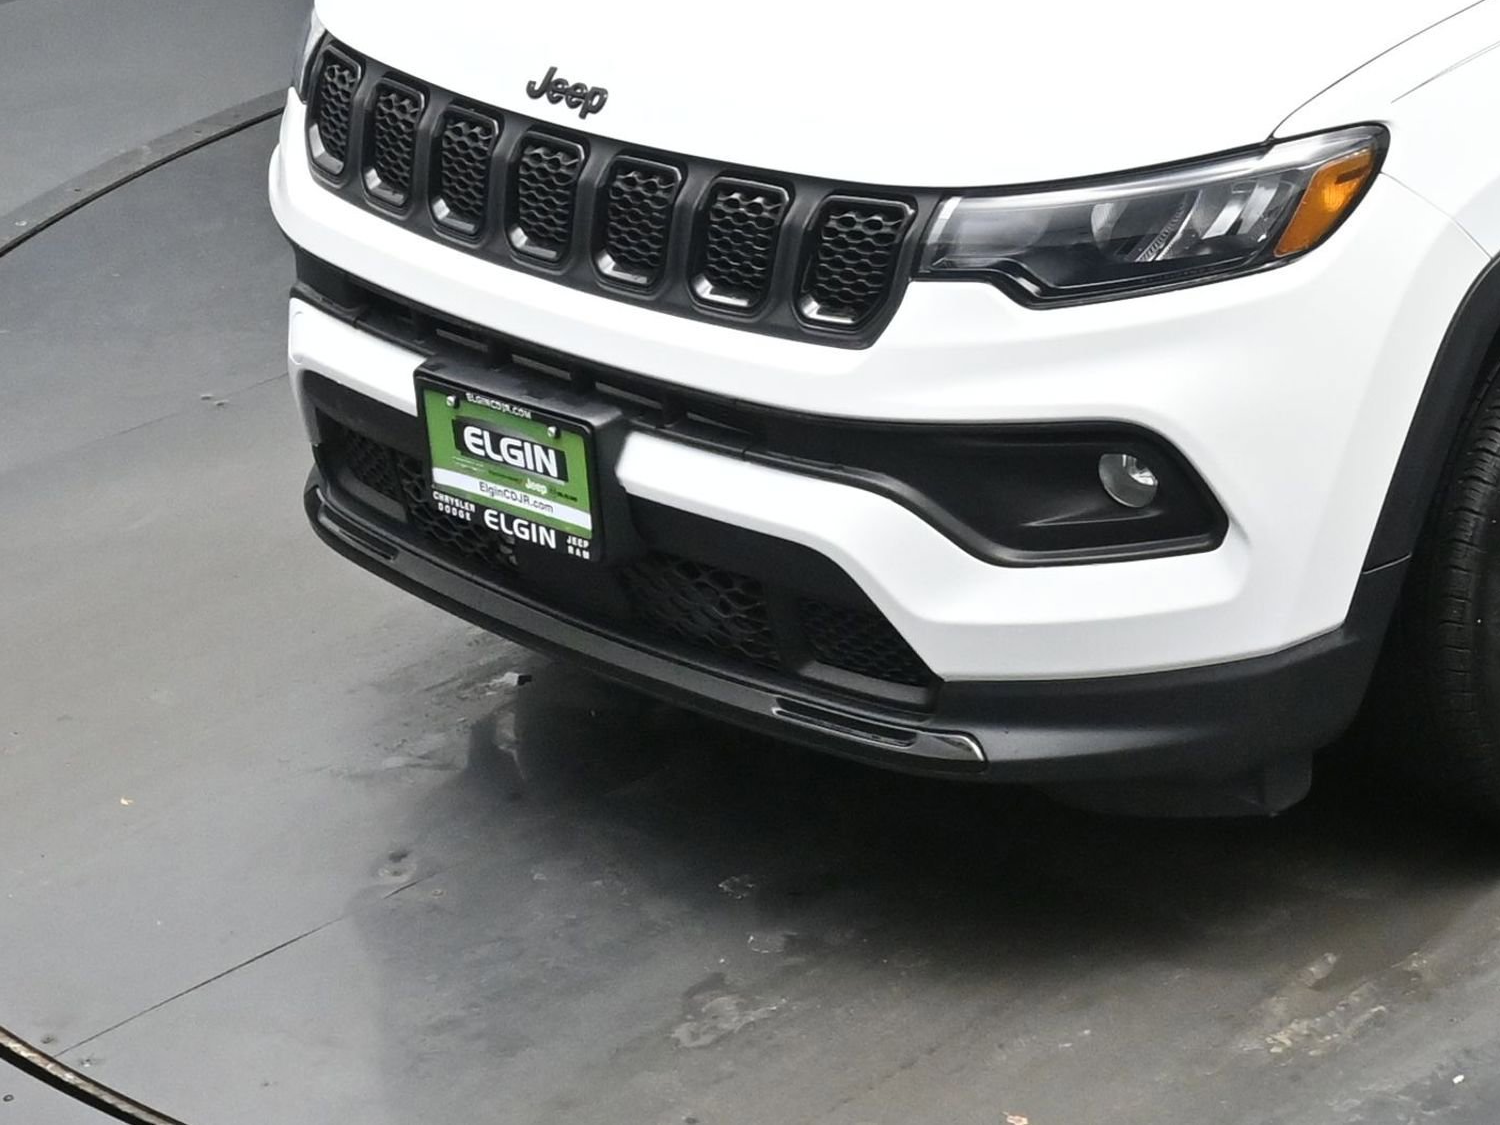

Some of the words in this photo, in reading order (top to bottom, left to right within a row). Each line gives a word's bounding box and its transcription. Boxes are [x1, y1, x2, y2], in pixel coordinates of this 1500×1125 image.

[526, 66, 609, 120] Jeep
[463, 426, 559, 478] ELGIN
[432, 490, 476, 513] CHRYSLER
[438, 501, 472, 521] DODGE
[479, 481, 554, 514] ElginCDJR.com
[483, 508, 557, 550] ELGIN
[566, 535, 589, 549] JEEP
[567, 545, 590, 560] RAM
